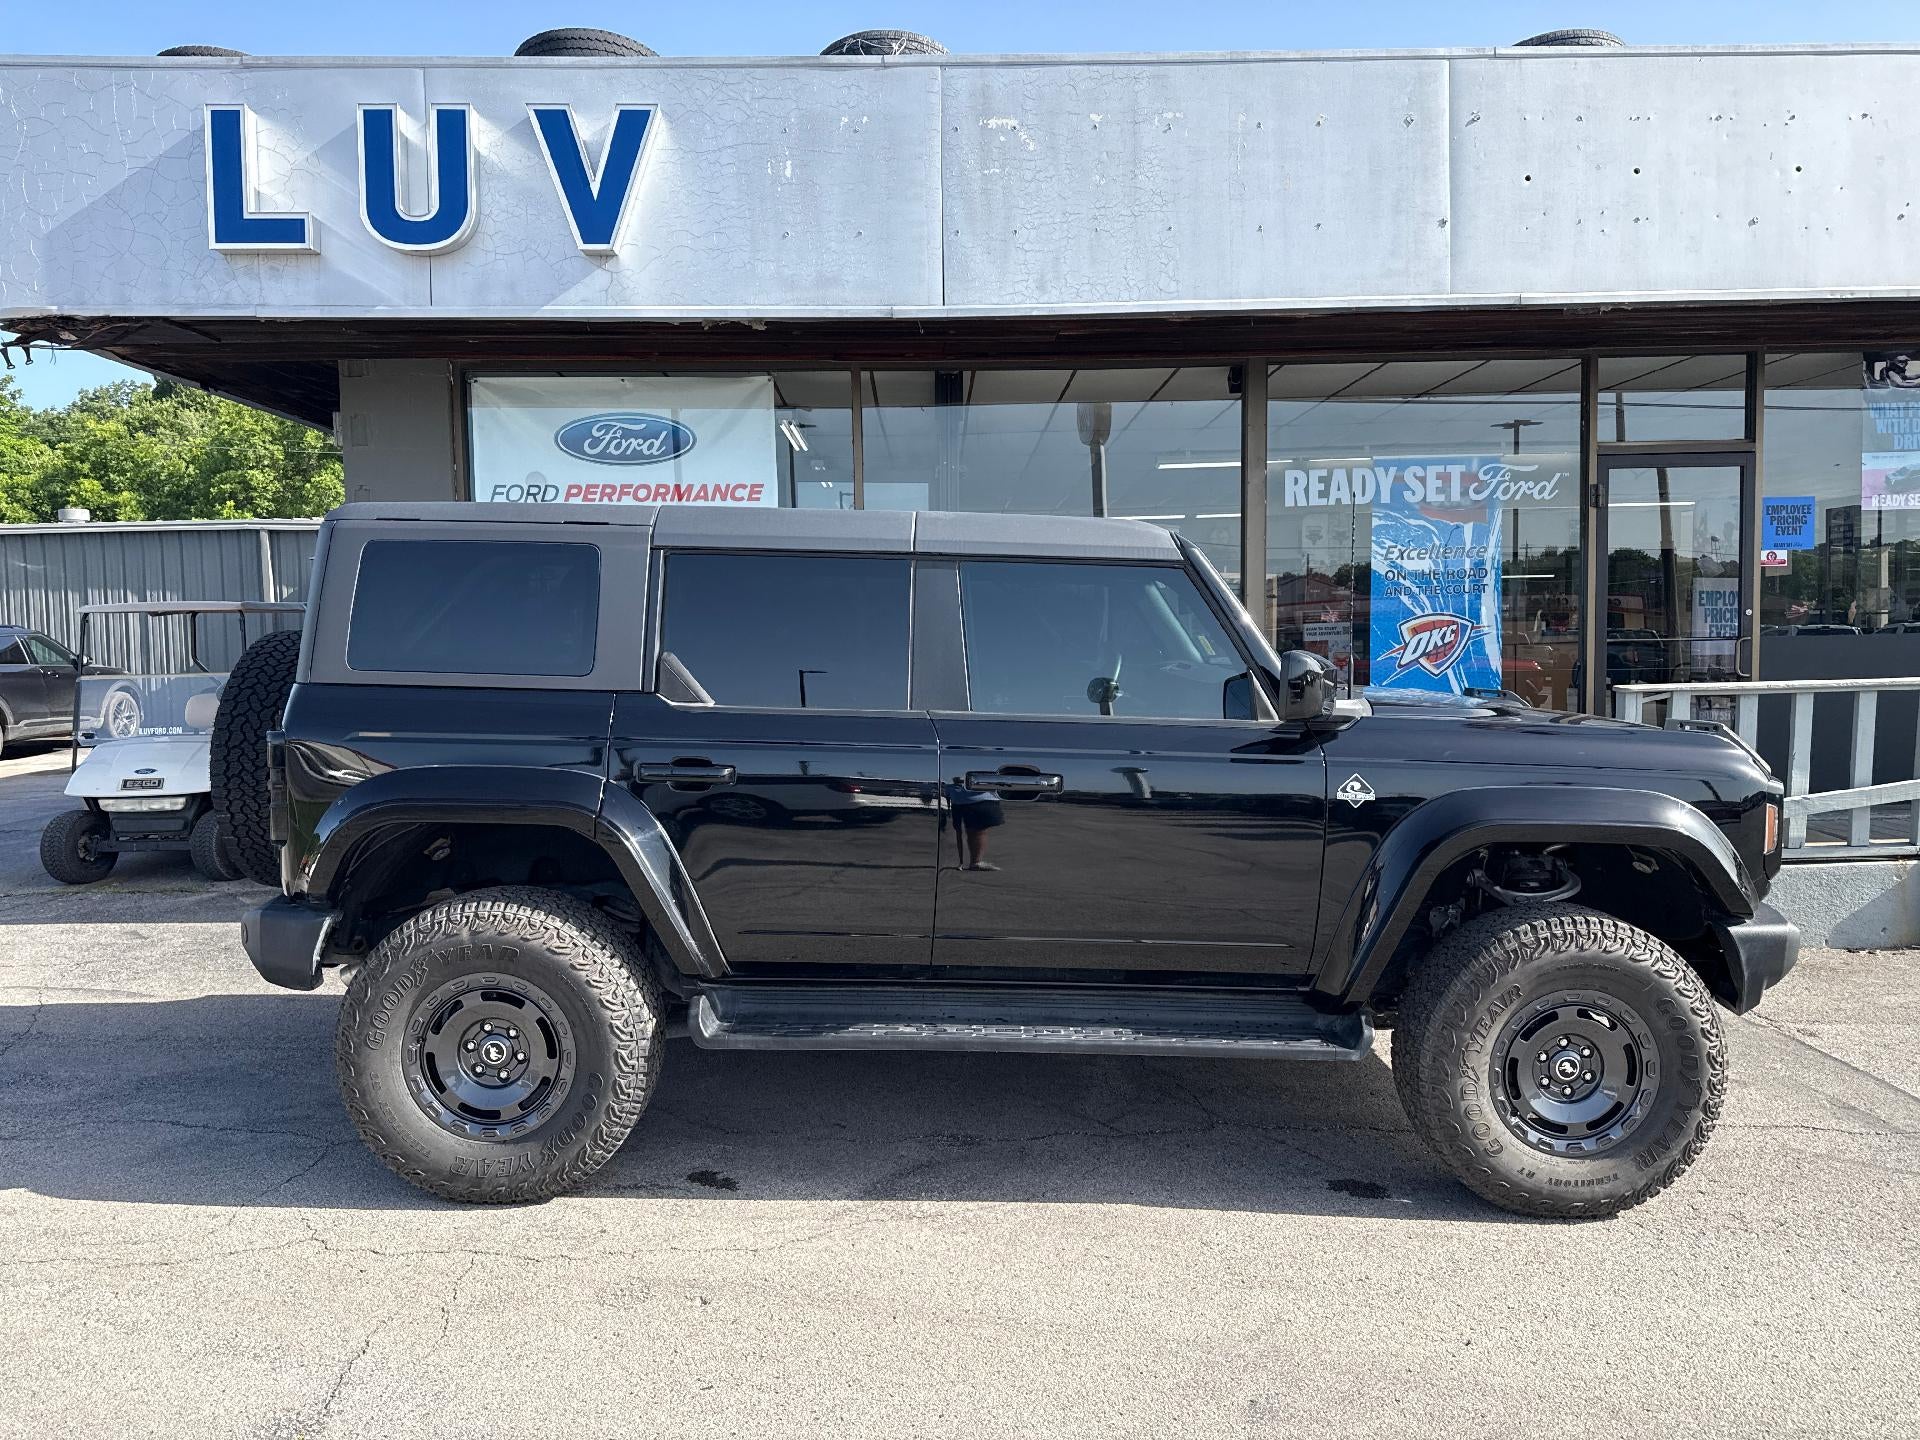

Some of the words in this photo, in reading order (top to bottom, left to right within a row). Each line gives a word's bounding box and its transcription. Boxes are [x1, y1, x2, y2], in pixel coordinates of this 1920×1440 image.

[204, 103, 661, 256] LUV
[583, 421, 668, 456] Ford
[490, 484, 560, 502] FORD
[564, 483, 765, 503] PERFORMANCE
[1284, 467, 1398, 507] READY
[1403, 465, 1466, 503] SET
[1468, 463, 1560, 501] Ford
[1871, 494, 1907, 507] READY
[1766, 504, 1812, 516] EMPLOYEE
[1770, 515, 1807, 526] PRICING
[1775, 526, 1803, 536] EVENT
[1383, 544, 1488, 561] Excellence
[1385, 569, 1407, 581] ON
[1415, 568, 1441, 580] THE
[1446, 567, 1488, 580] ROAD
[1384, 585, 1412, 597] AND
[1416, 585, 1441, 596] THE
[1445, 583, 1488, 595] COURT
[1698, 590, 1739, 607] EMPLO
[1704, 607, 1738, 623] PRICI
[1708, 623, 1738, 638] EVEN
[1400, 624, 1458, 665] OKC
